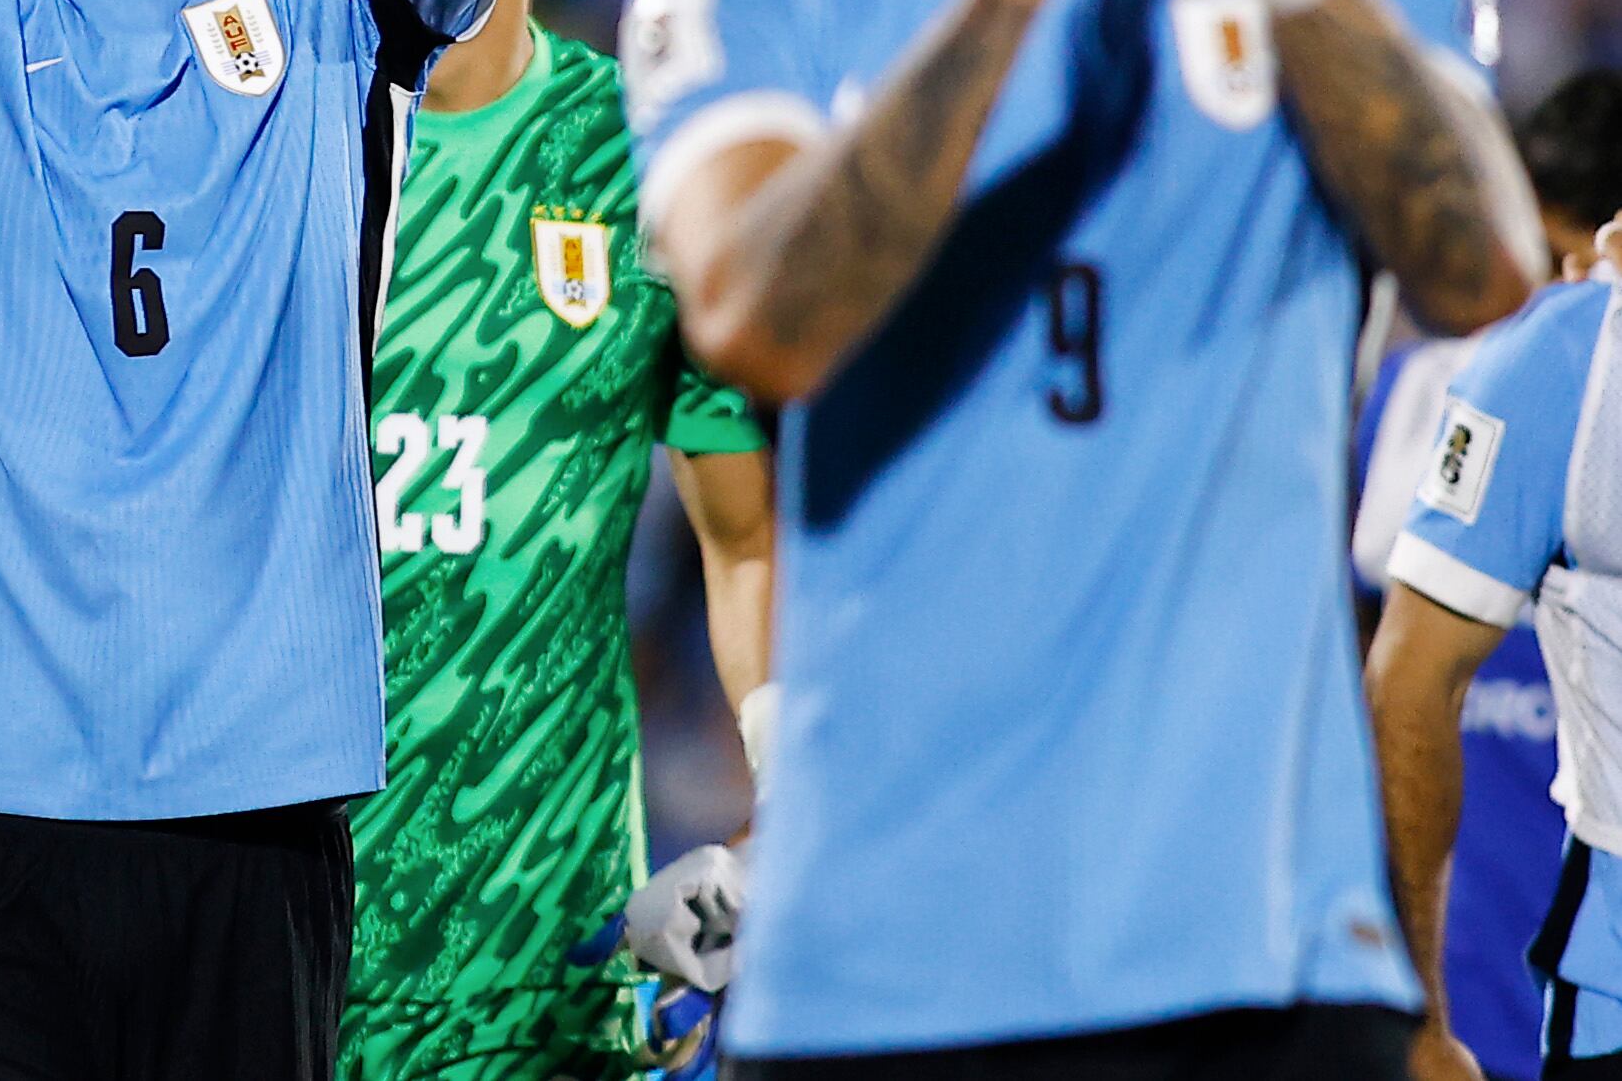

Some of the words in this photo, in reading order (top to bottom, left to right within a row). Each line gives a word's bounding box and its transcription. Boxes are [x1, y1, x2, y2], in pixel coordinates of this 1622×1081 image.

[222, 15, 248, 51] AUF
[110, 211, 171, 357] 6
[1050, 263, 1102, 425] 9
[376, 411, 488, 554] 23
